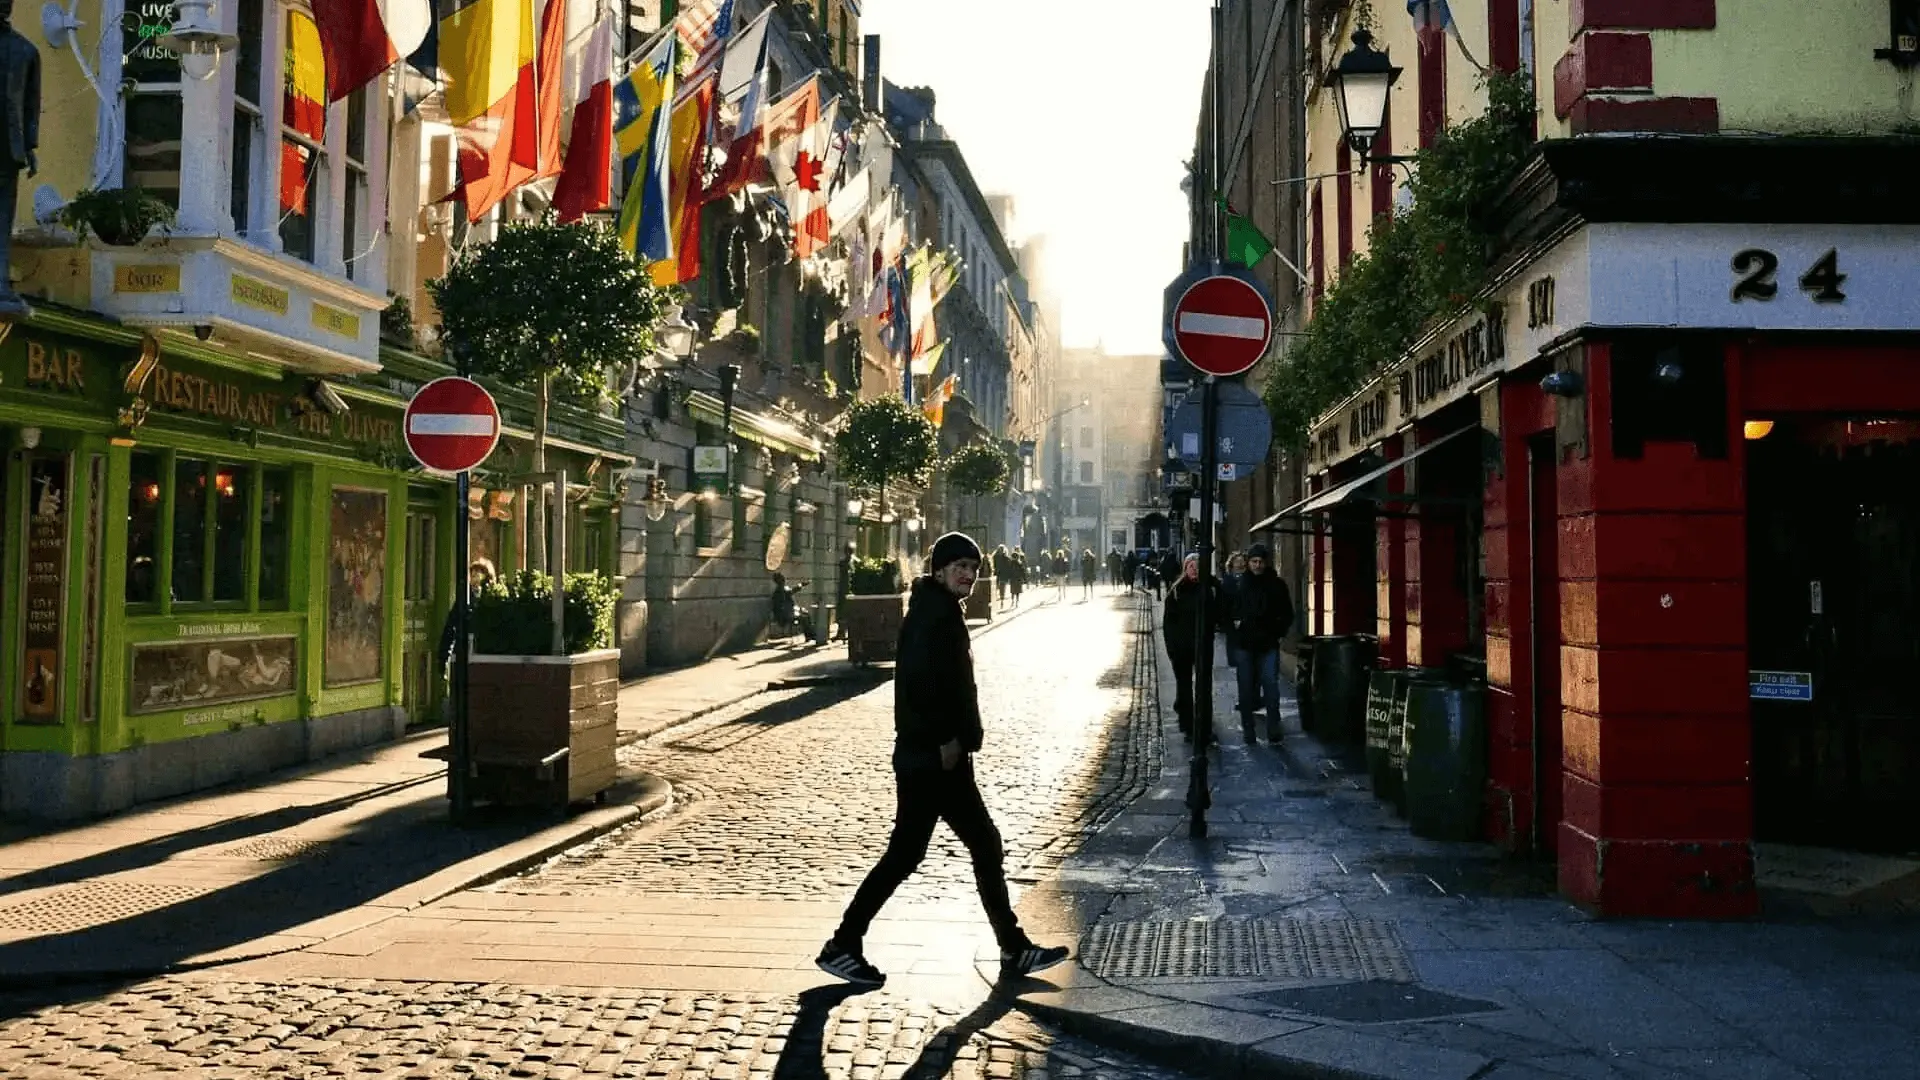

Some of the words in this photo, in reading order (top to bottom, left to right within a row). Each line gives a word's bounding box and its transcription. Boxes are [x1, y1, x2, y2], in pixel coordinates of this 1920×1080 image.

[142, 4, 173, 17] LIVE
[27, 341, 85, 388] BAR
[154, 364, 281, 426] RESTAURANT
